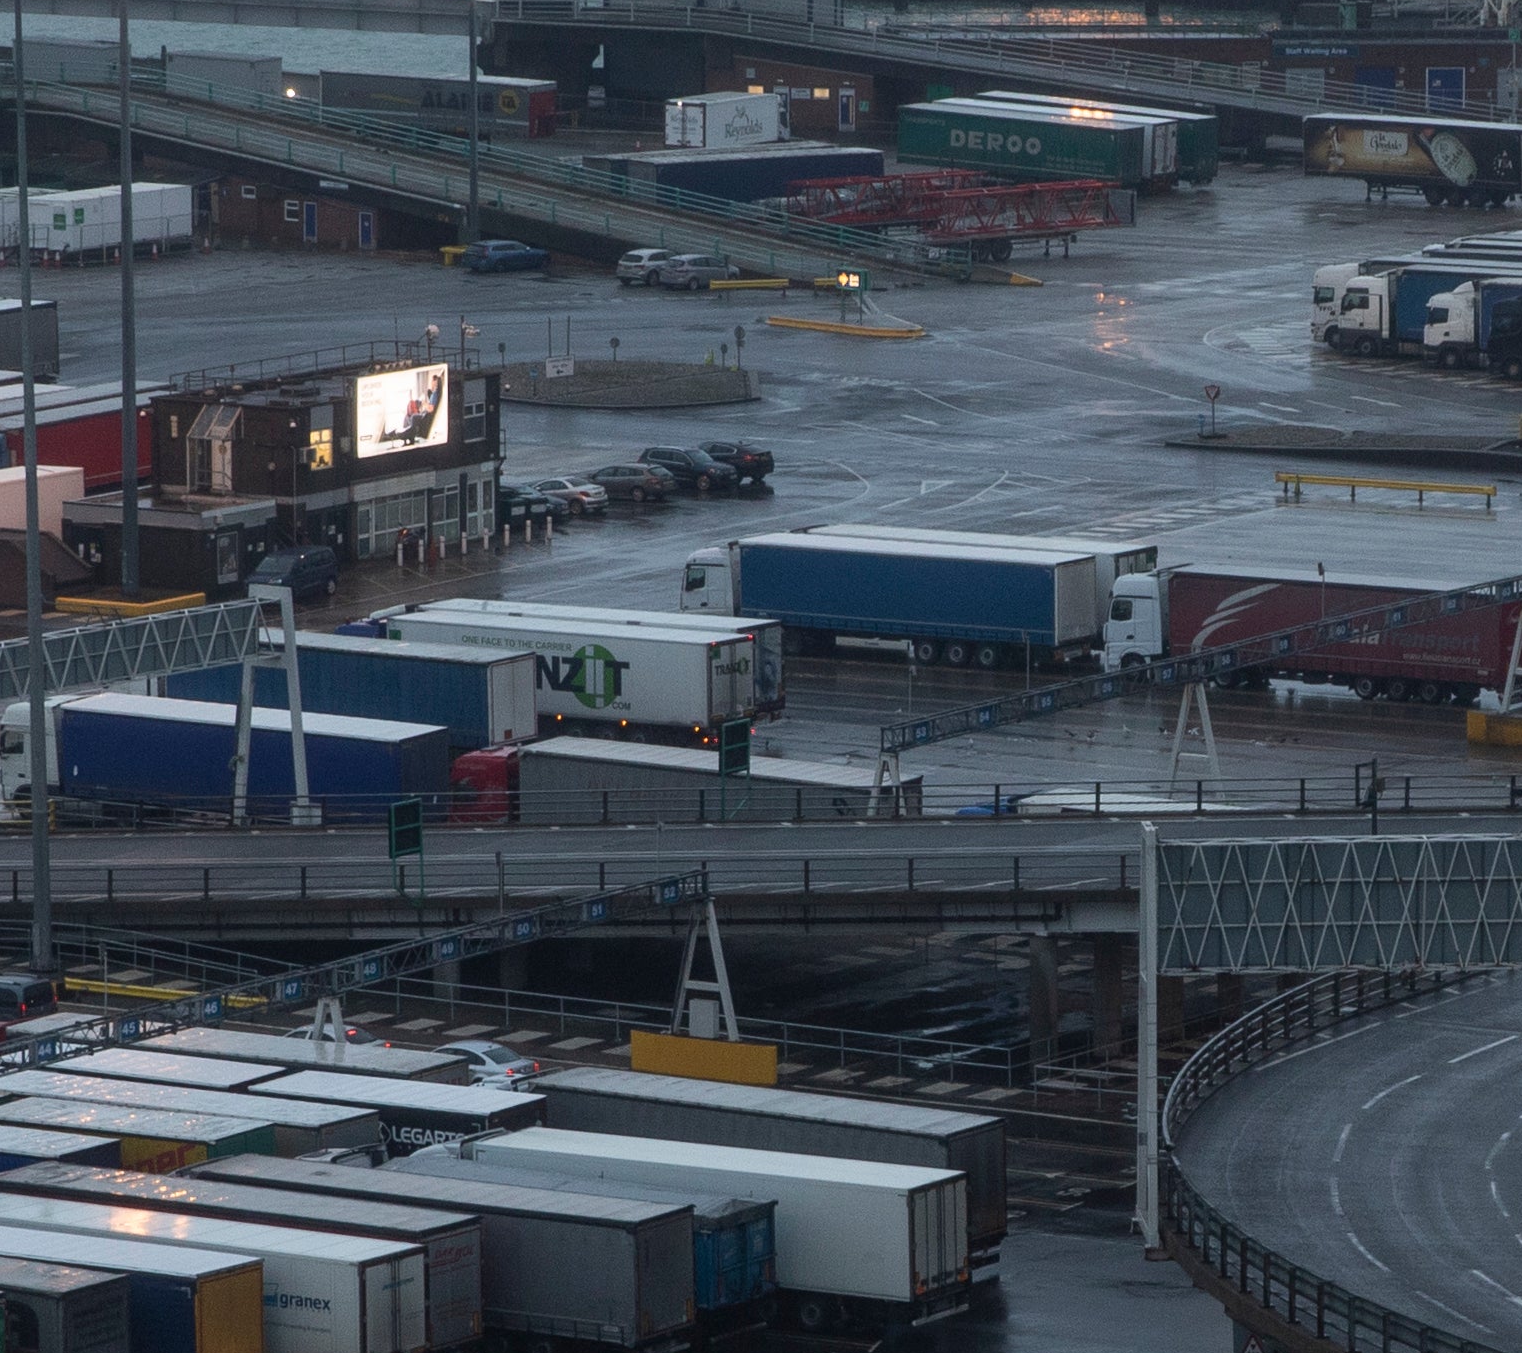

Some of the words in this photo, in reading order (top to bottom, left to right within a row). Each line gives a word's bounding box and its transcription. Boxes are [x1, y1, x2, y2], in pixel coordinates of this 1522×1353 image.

[724, 121, 763, 142] Reynolds
[949, 128, 1042, 155] DEROO
[1336, 624, 1347, 636] 60
[461, 634, 479, 645] ONE
[481, 636, 502, 647] FACE
[504, 638, 516, 647] TO
[517, 639, 532, 649] THE
[535, 640, 572, 652] CARRIER
[1278, 639, 1289, 651] 59
[1220, 653, 1232, 665] 58
[1162, 668, 1174, 680] 57
[1101, 682, 1113, 693] 56
[612, 701, 631, 711] COM
[1041, 696, 1052, 707] 55
[979, 710, 991, 722] 54
[915, 727, 927, 738] 53
[663, 886, 677, 898] 52
[591, 904, 604, 916] 51
[516, 923, 530, 935] 50
[441, 942, 454, 955] 49
[363, 963, 378, 976] 48
[285, 983, 298, 995] 47
[204, 1002, 218, 1014] 46
[121, 1022, 136, 1035] 45
[37, 1043, 52, 1056] 44
[279, 1292, 331, 1311] granex
